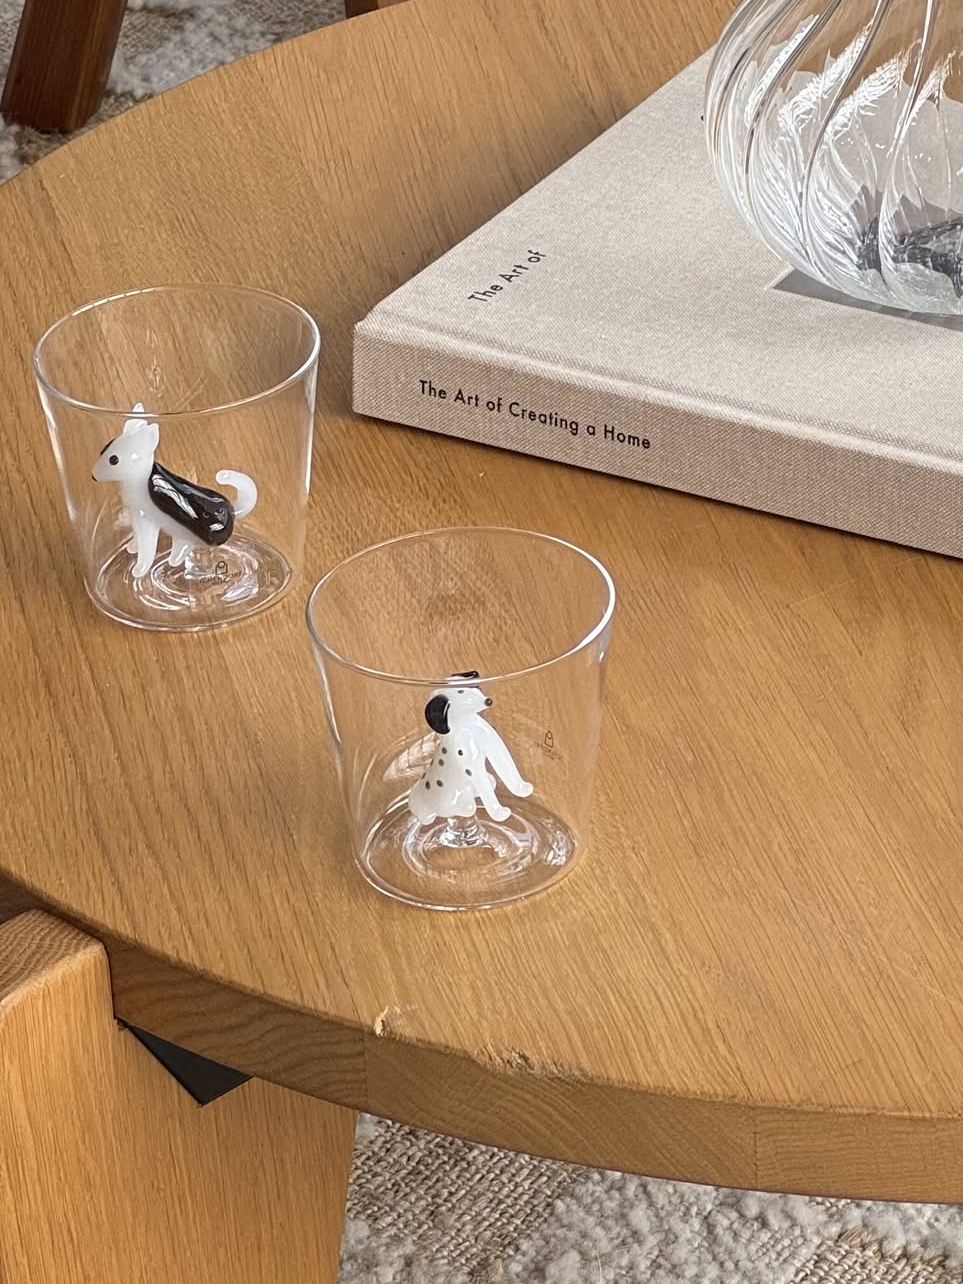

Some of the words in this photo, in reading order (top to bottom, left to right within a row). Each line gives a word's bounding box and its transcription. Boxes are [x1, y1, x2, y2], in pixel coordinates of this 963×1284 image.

[467, 283, 504, 303] The
[498, 263, 529, 283] Art
[528, 248, 547, 264] of
[419, 379, 448, 400] The
[454, 387, 480, 408] Art
[486, 397, 506, 413] of
[509, 401, 579, 437] Creating
[586, 425, 597, 436] a
[604, 424, 652, 450] Home
